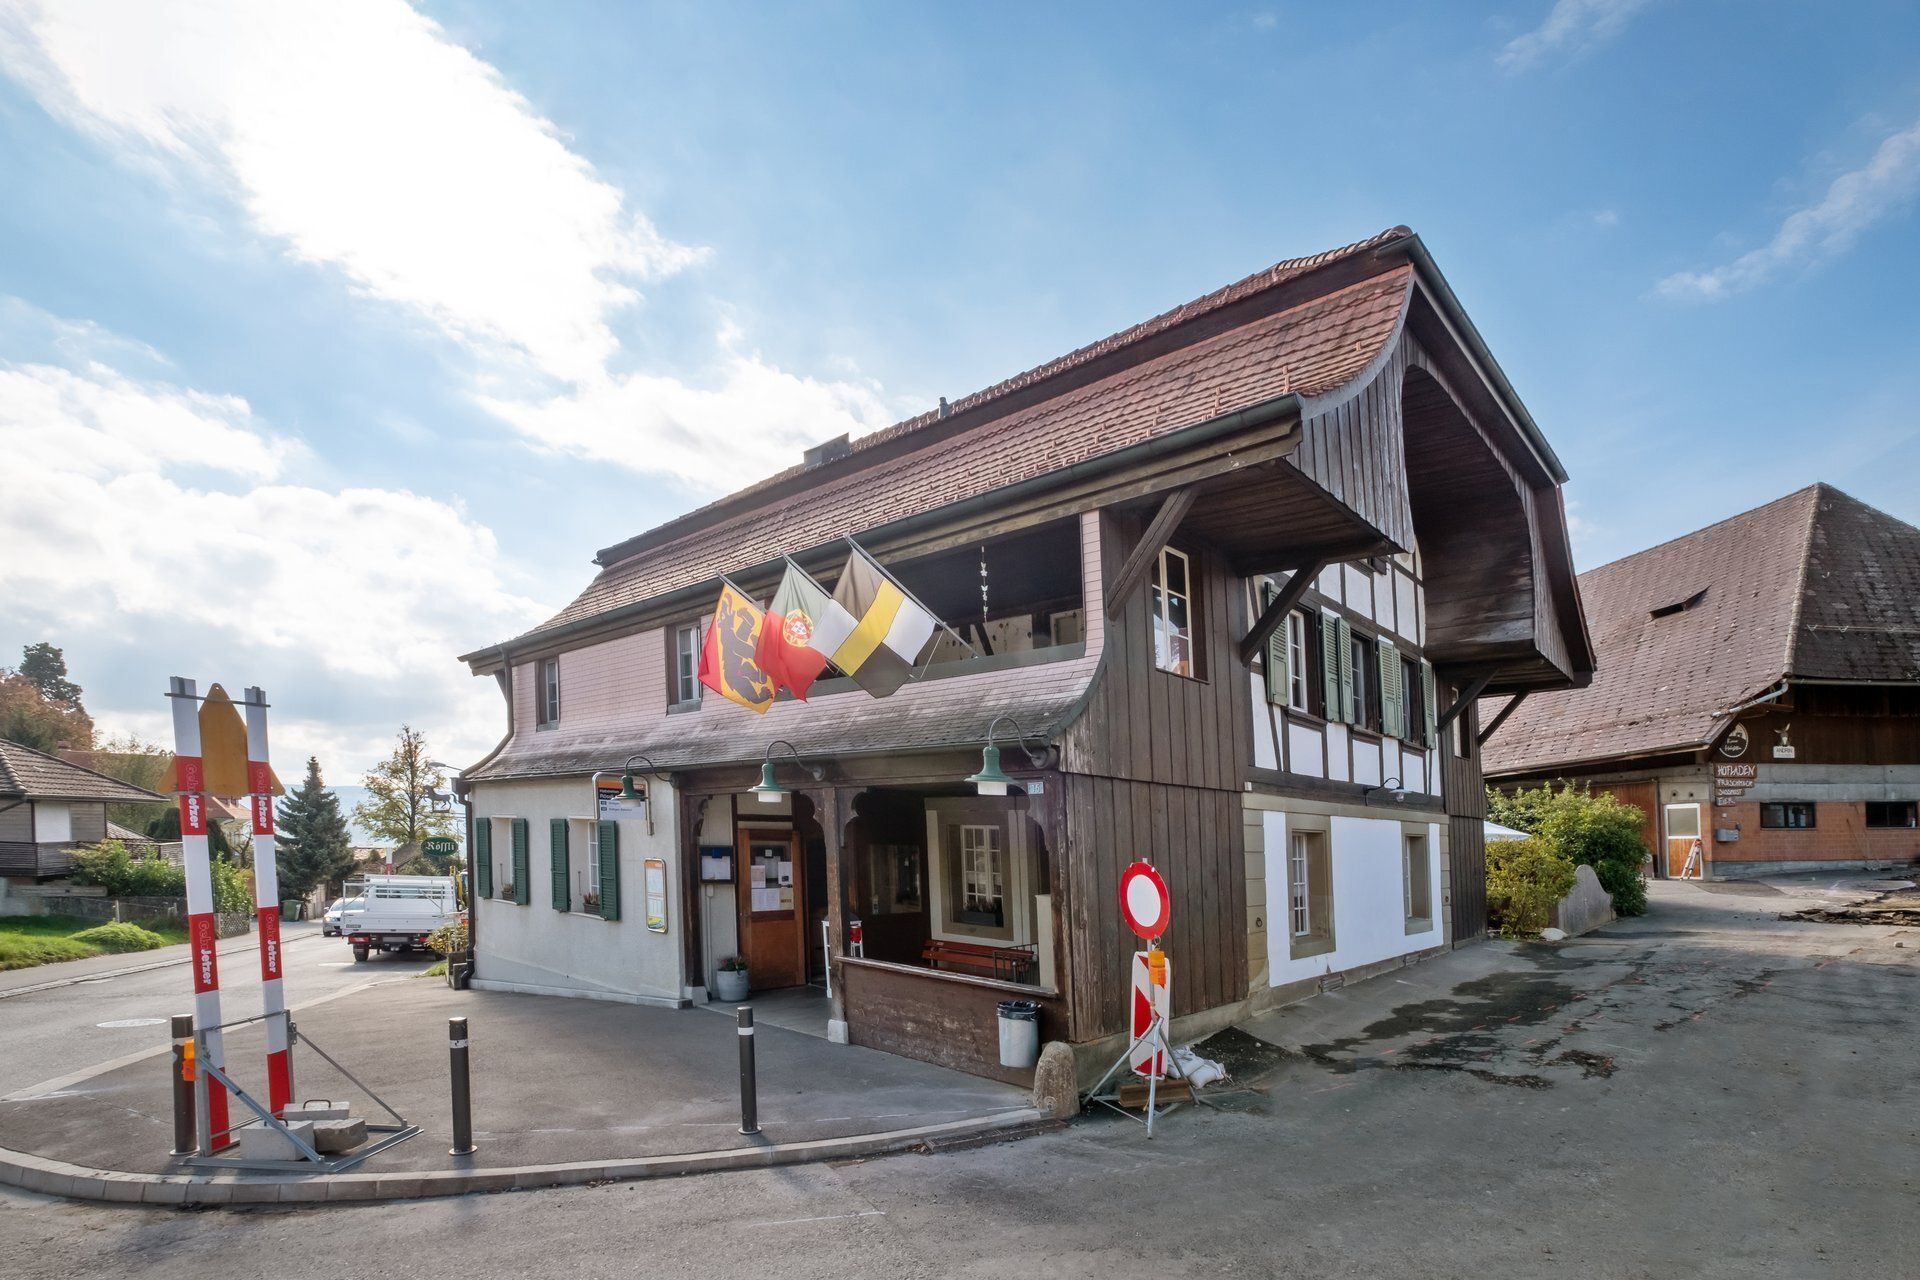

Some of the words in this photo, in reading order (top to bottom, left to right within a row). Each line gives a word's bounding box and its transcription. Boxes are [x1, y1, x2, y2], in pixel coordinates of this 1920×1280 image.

[1717, 764, 1756, 777] HOFLADEN
[201, 949, 212, 985] Jetzer
[267, 939, 278, 973] Jetzer
